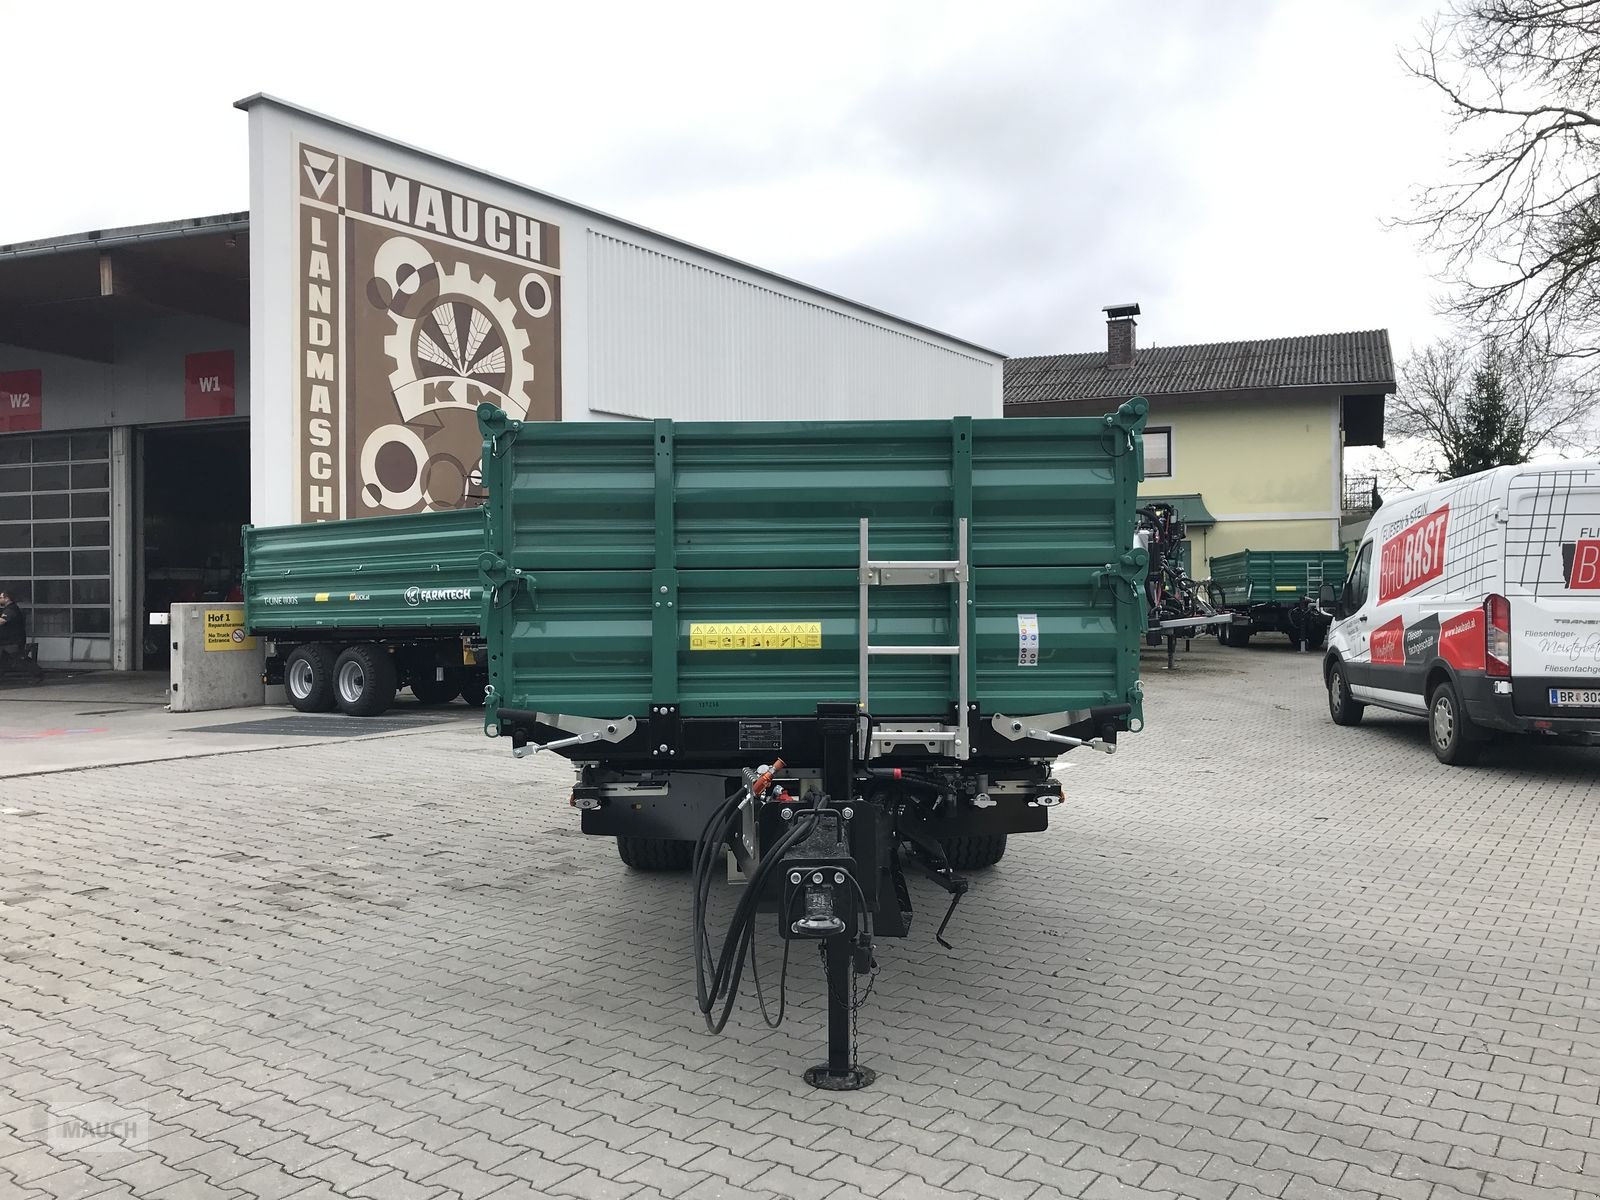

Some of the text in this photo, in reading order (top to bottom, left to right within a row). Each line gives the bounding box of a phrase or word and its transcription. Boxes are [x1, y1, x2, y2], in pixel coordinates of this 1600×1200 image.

[370, 169, 541, 261] MAUCH
[306, 216, 334, 522] LANDMASCH
[199, 376, 221, 392] W1
[9, 392, 31, 408] W2
[1380, 513, 1446, 599] BAUBAST
[420, 589, 471, 602] FARMTECH
[208, 613, 230, 621] Hof 1
[1444, 618, 1476, 638] www.baubast.at
[1524, 630, 1577, 639] Fliesenleger-
[1560, 692, 1575, 702] BR
